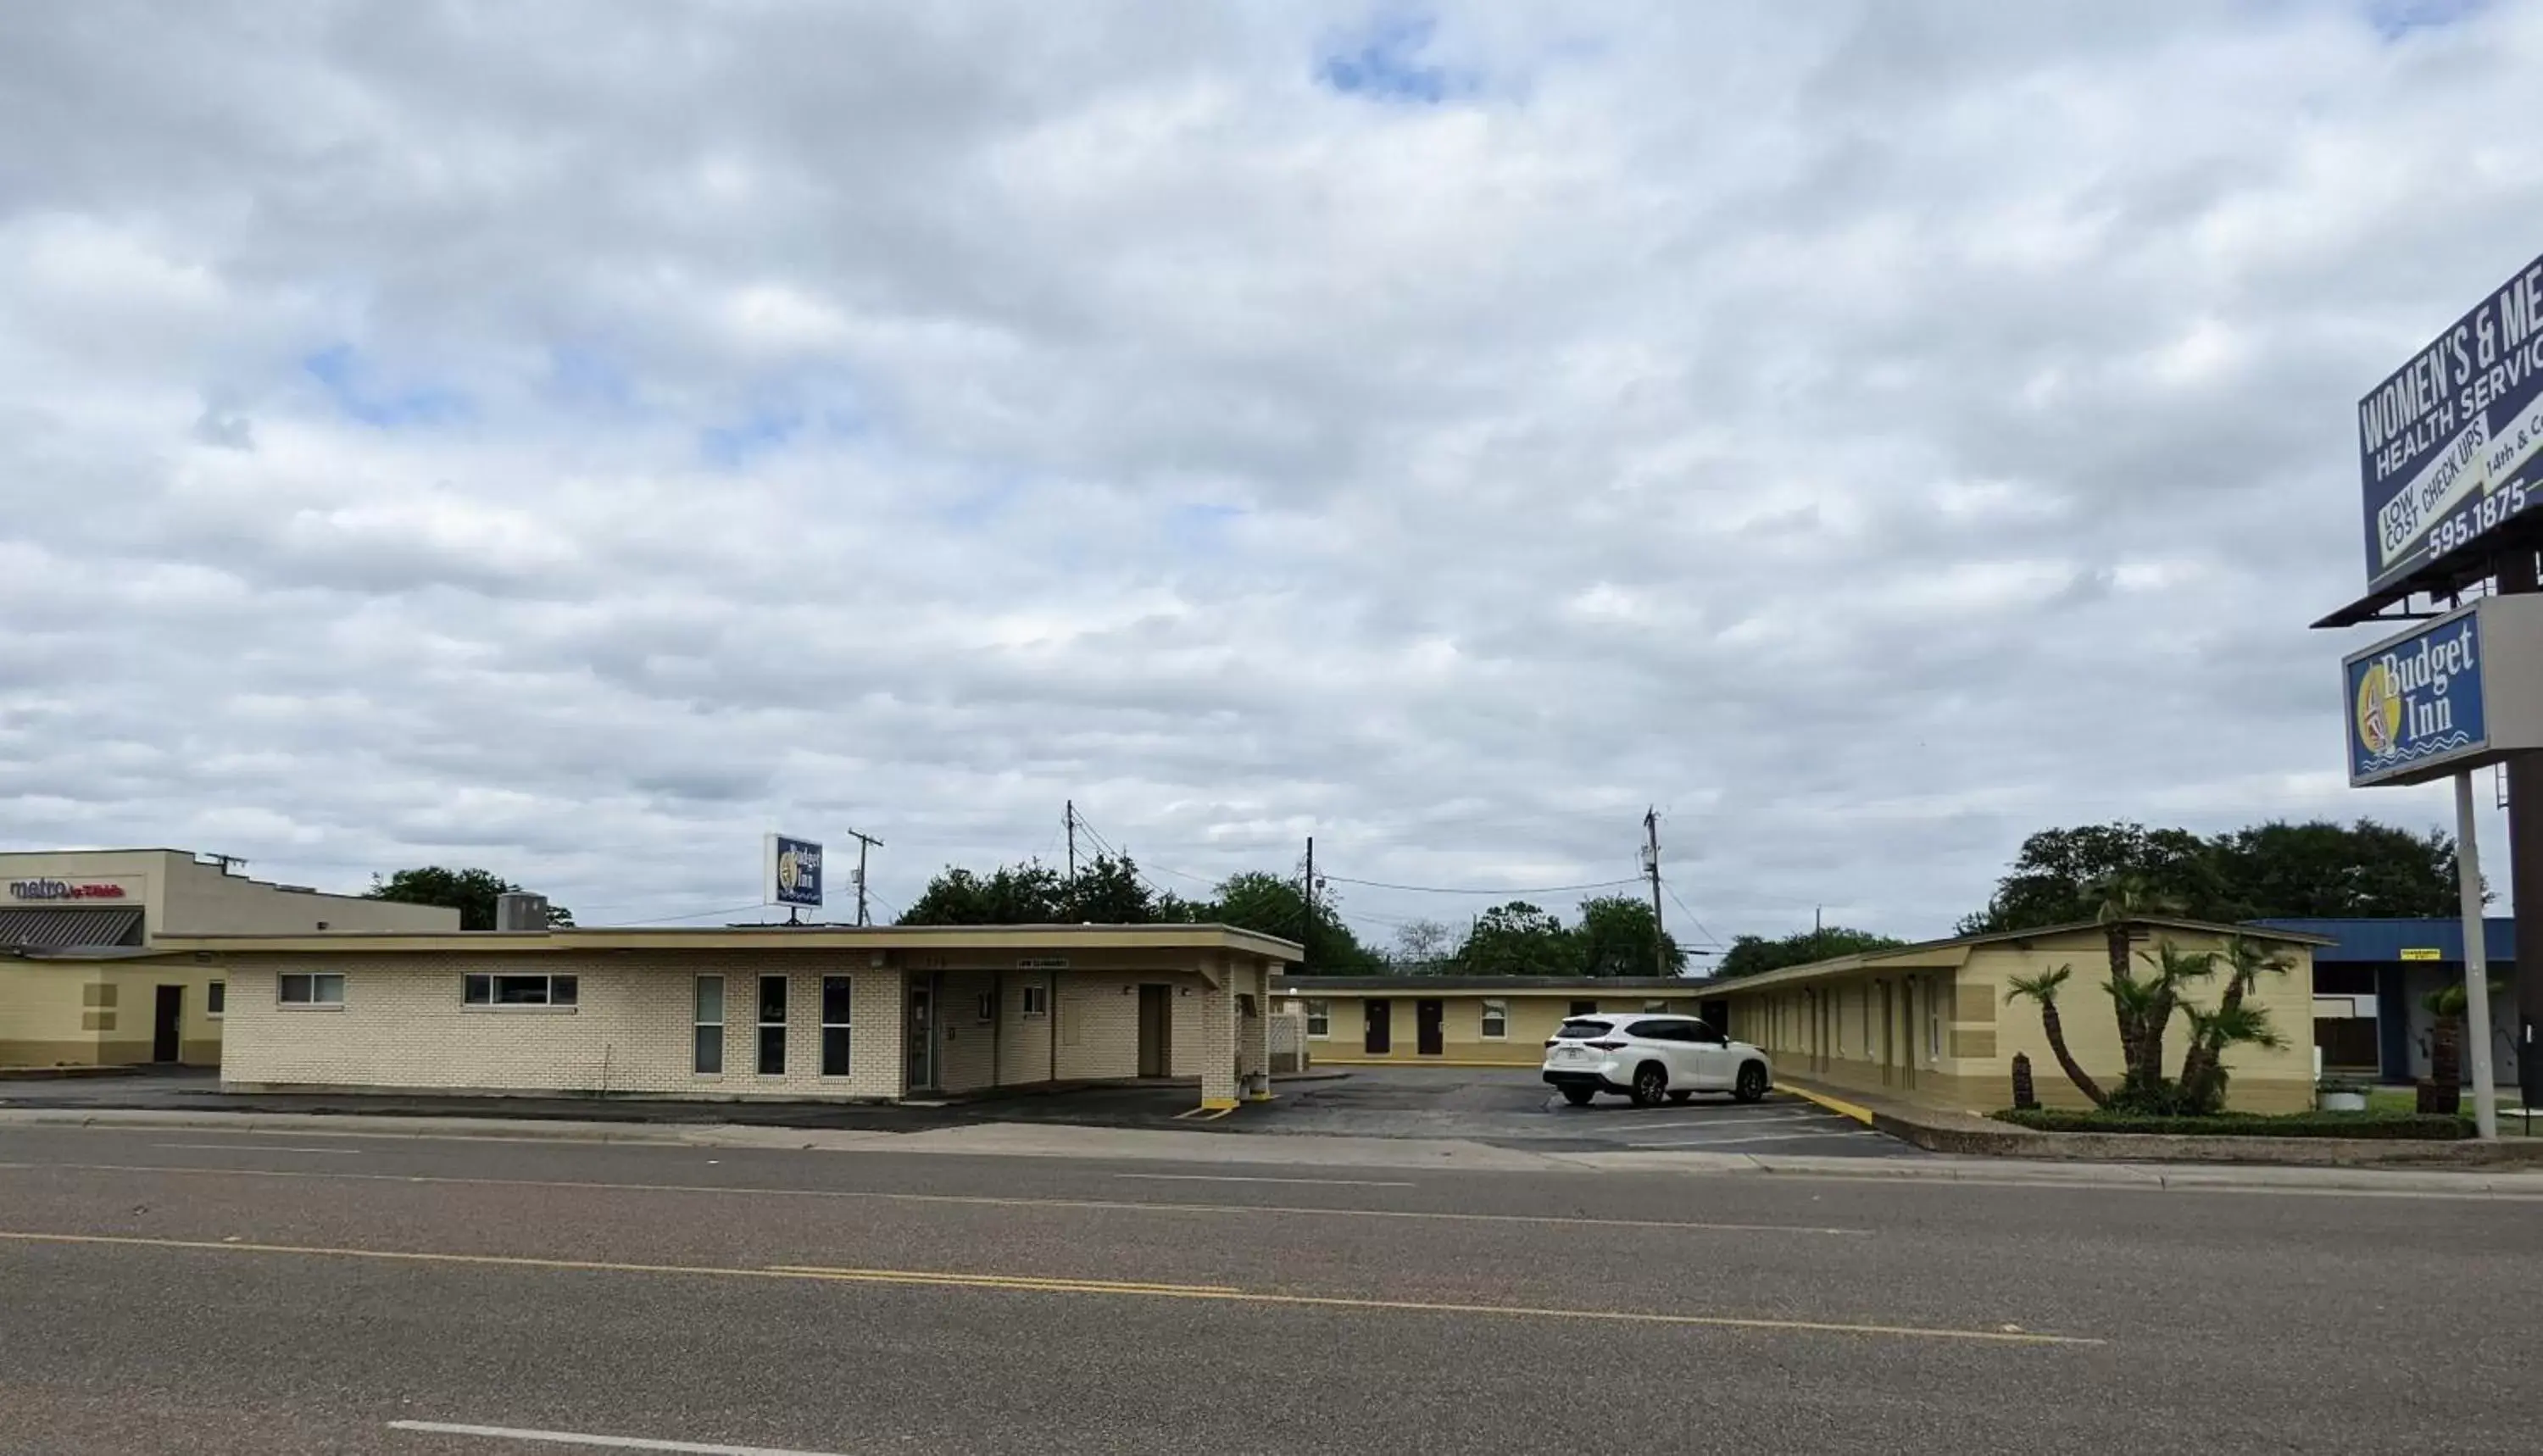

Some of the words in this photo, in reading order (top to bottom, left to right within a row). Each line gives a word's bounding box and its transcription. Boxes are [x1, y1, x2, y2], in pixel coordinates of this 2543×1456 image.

[2362, 325, 2470, 455] WOMEN'S
[2476, 305, 2496, 370] &
[2375, 400, 2455, 481] HEALTH
[2487, 444, 2514, 478] 14th
[2518, 431, 2529, 450] &
[2422, 451, 2460, 513] CHECK
[2458, 420, 2484, 465] UPS
[2384, 486, 2414, 529] LOW
[2385, 506, 2418, 552] COST
[2429, 478, 2526, 560] 595.1875
[2381, 622, 2473, 698] Budget
[2406, 696, 2453, 741] Inn
[10, 876, 69, 899] metro
[798, 867, 814, 889] Inn
